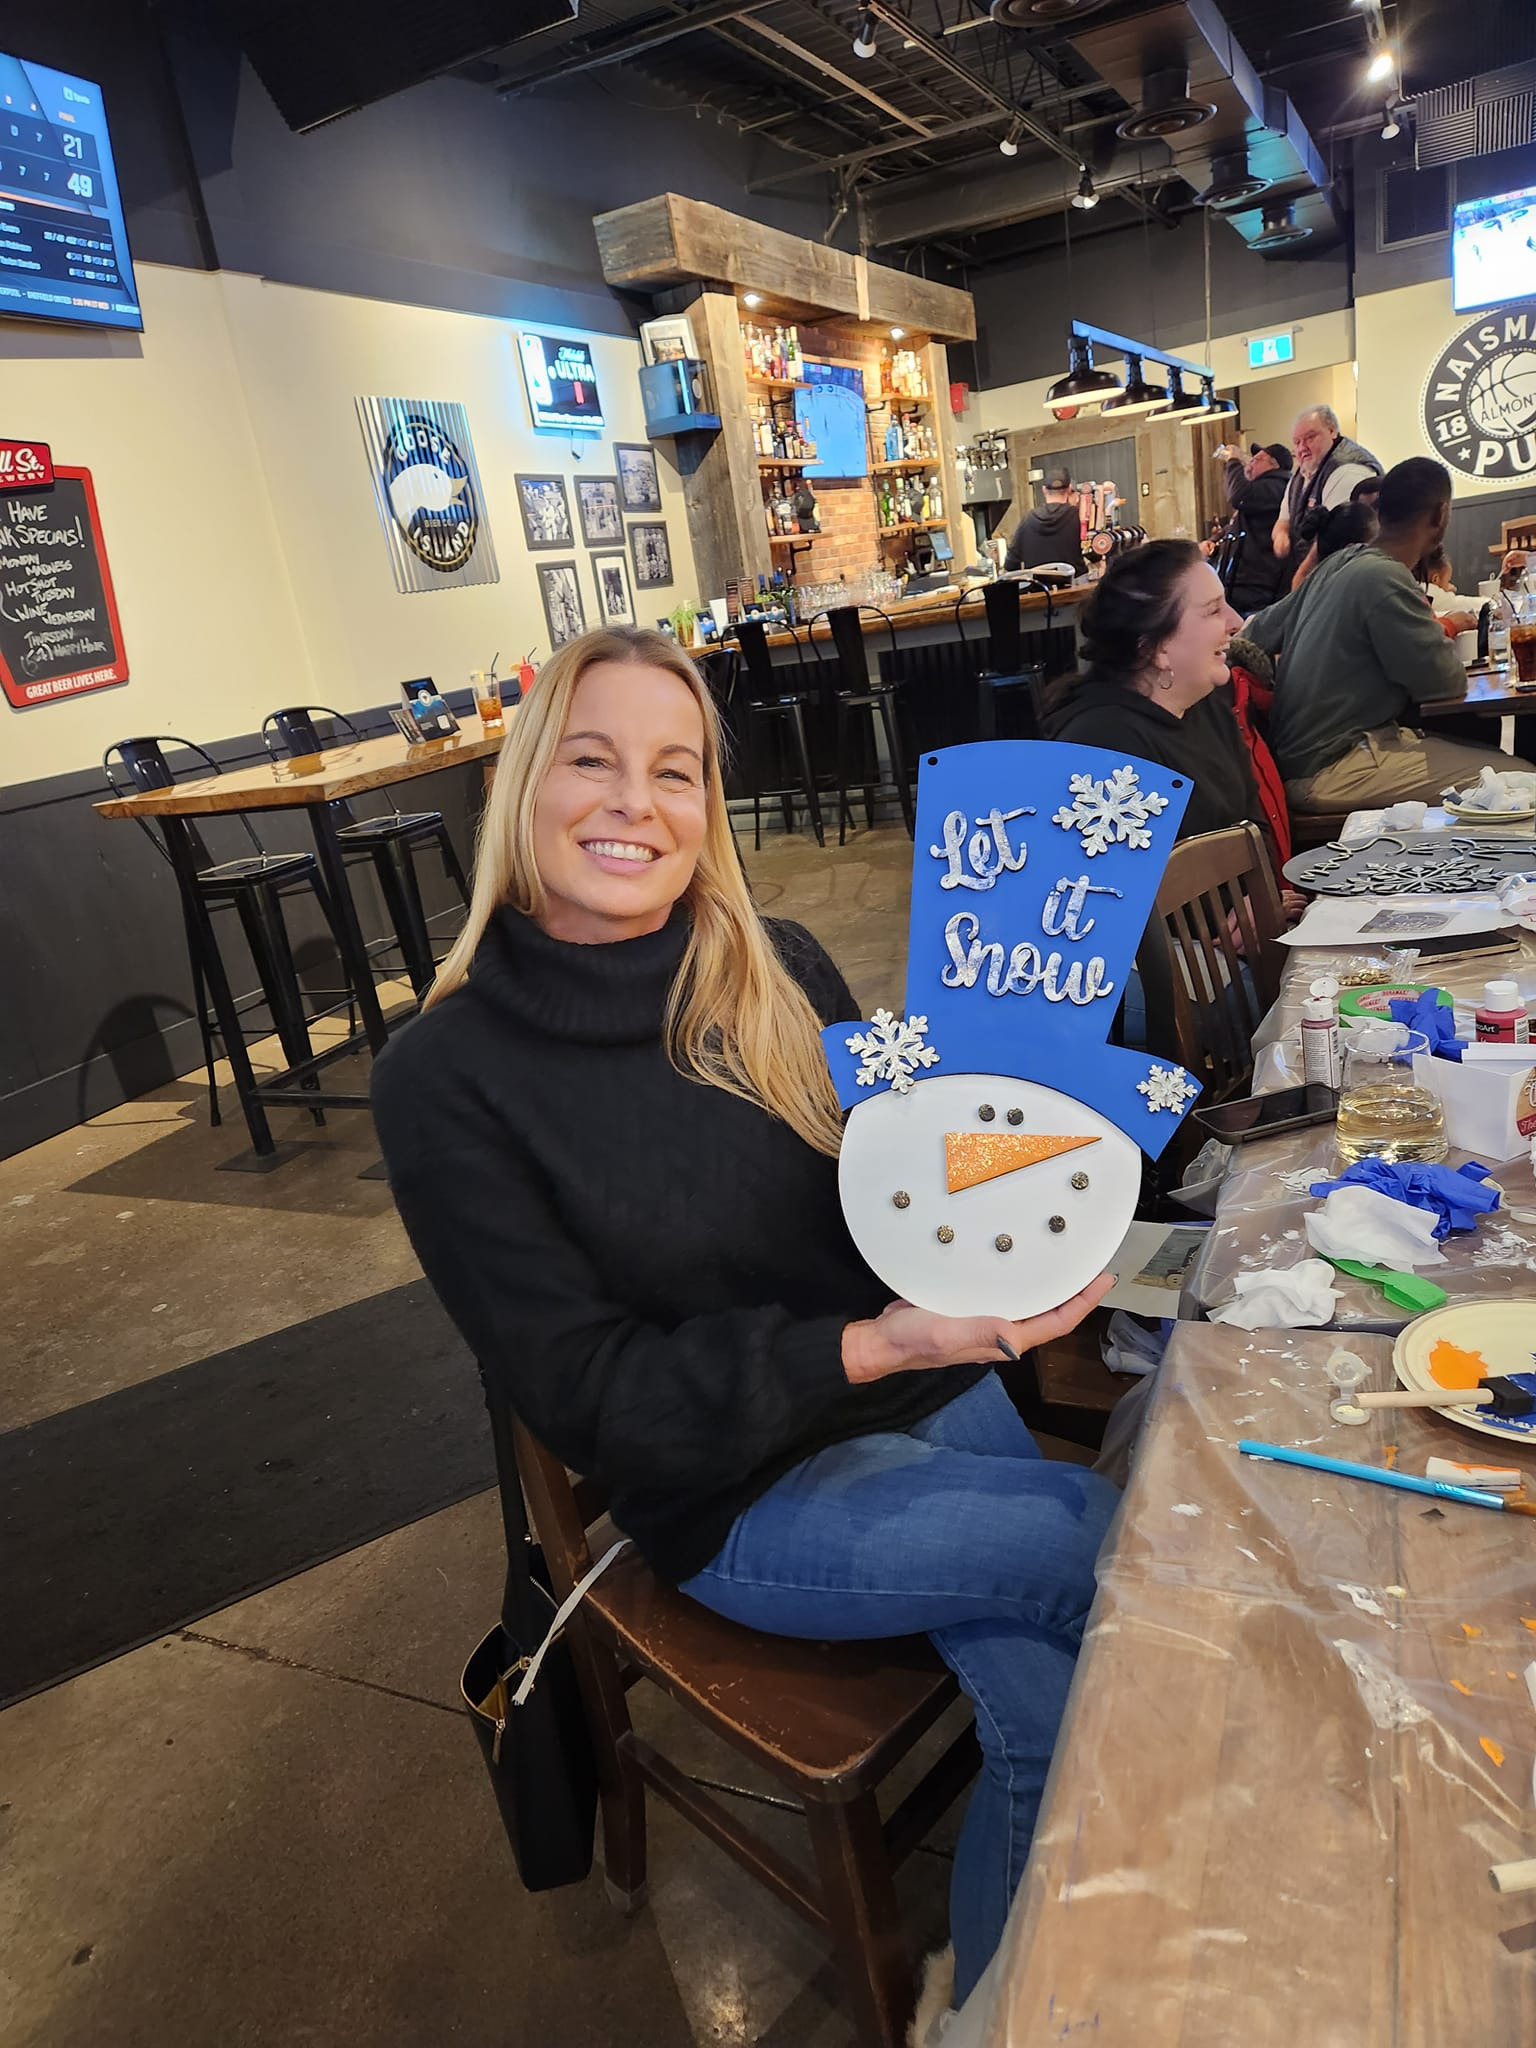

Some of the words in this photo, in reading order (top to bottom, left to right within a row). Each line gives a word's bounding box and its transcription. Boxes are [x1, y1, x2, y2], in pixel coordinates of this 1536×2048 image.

[62, 133, 83, 159] 21
[67, 172, 93, 198] 49
[554, 360, 595, 383] ULTRA
[1436, 415, 1468, 441] 18
[396, 430, 451, 464] GOOSE
[15, 448, 45, 473] St.
[8, 501, 48, 523] HAVE
[15, 515, 86, 547] SPECIALS!
[413, 521, 469, 558] ISLAND
[31, 587, 75, 604] TUESDAY
[15, 603, 49, 621] WINE
[24, 627, 74, 649] THURSDAY
[26, 682, 53, 699] GREAT
[52, 678, 73, 693] BEER
[72, 672, 95, 689] LIVES
[93, 668, 117, 684] HERE.
[930, 806, 1036, 890] Let
[1041, 875, 1123, 941] it
[941, 911, 1114, 1005] Snow
